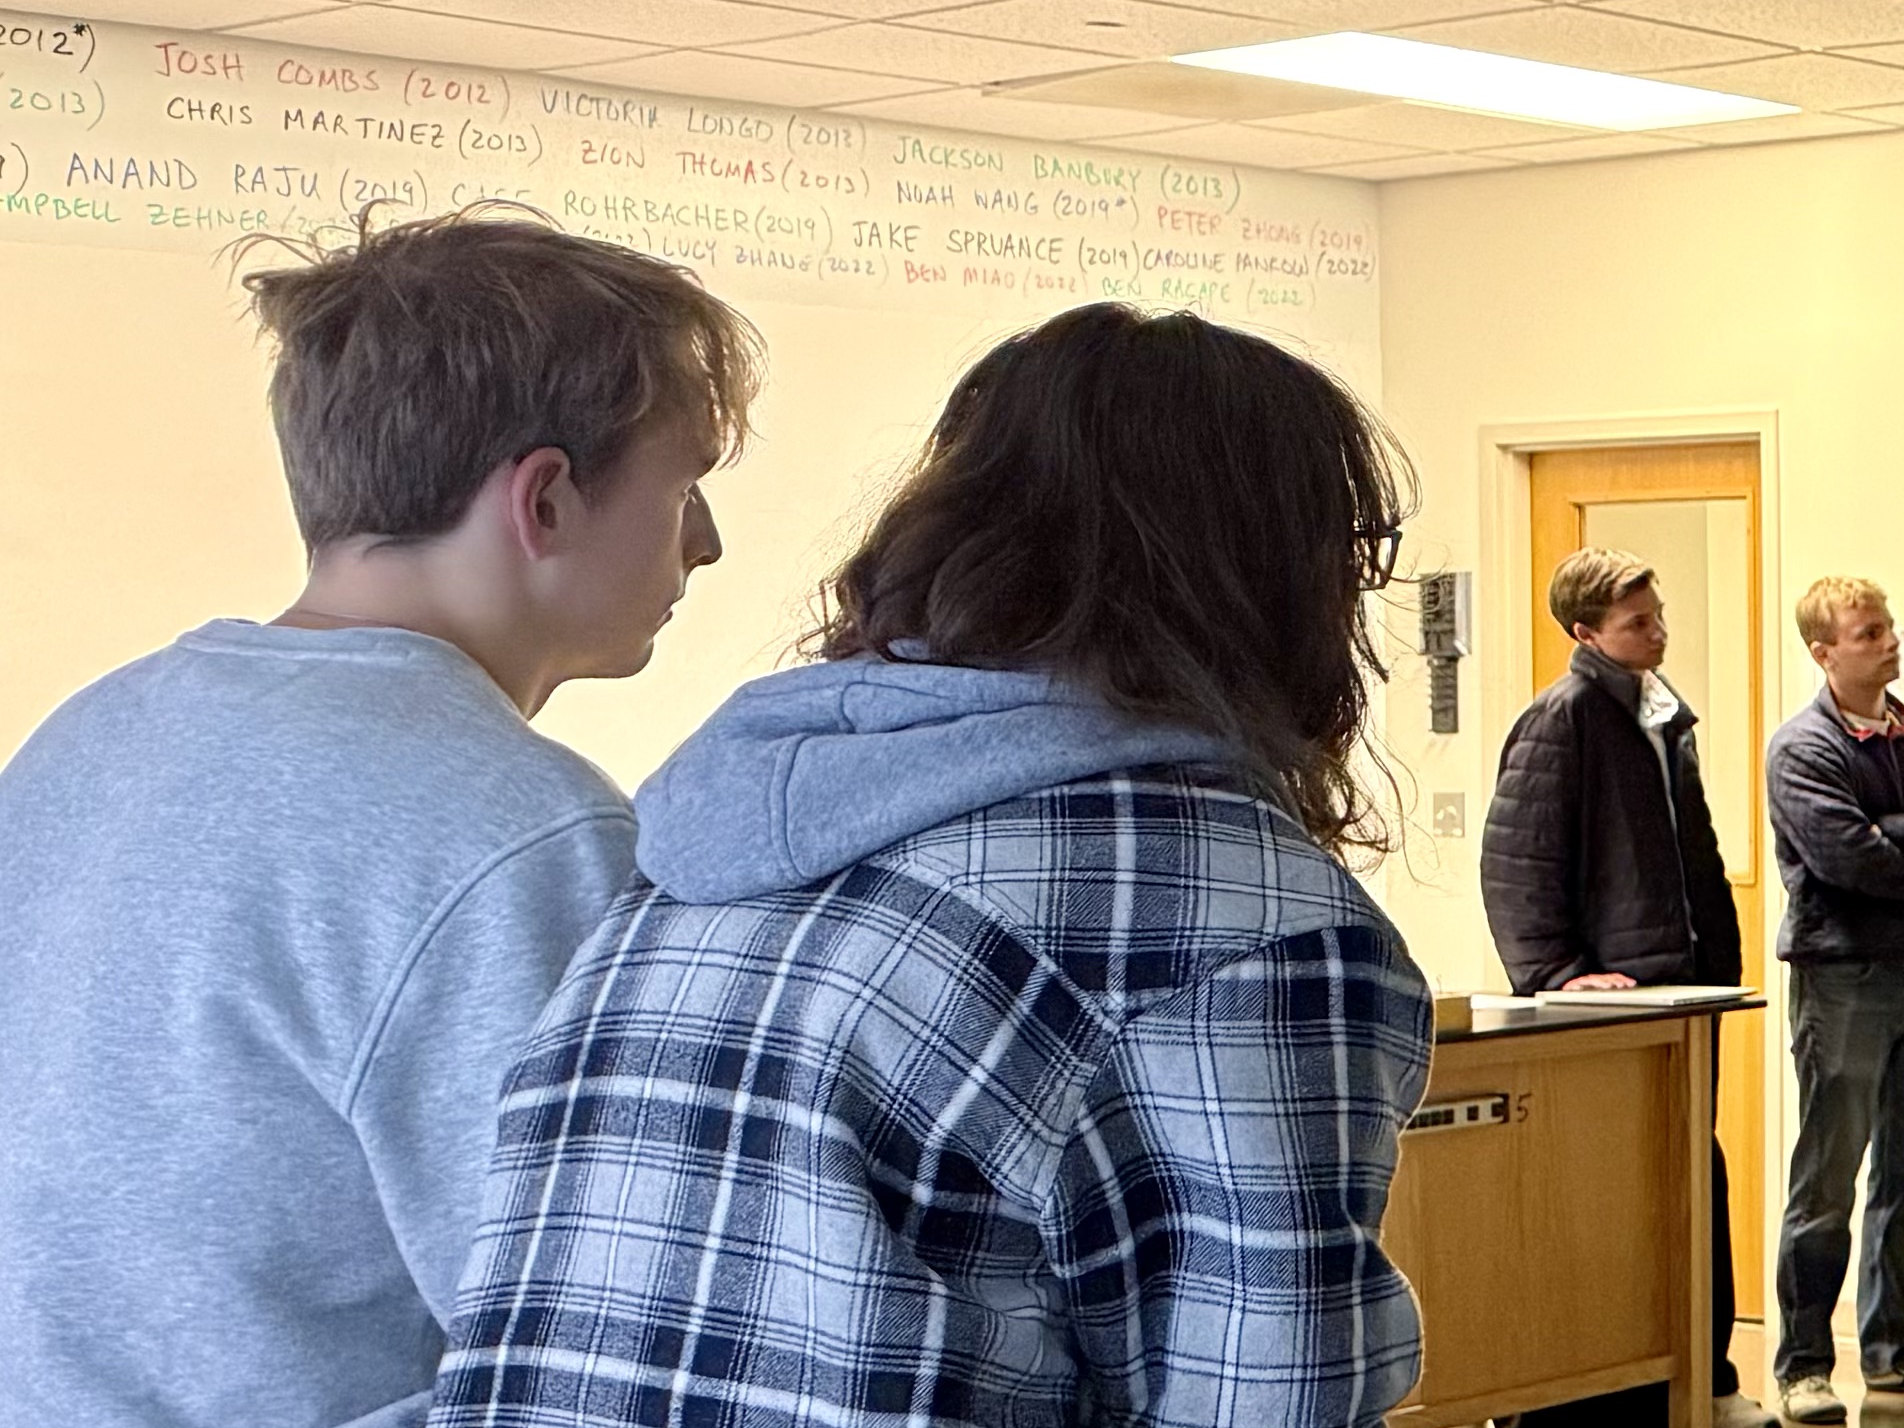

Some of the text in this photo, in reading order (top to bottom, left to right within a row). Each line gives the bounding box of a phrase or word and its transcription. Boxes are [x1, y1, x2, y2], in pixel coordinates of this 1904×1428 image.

[156, 42, 243, 80] JOSH
[278, 60, 379, 92] COMBS
[404, 68, 510, 122] (2012)
[687, 107, 774, 142] LONGO
[894, 136, 1004, 171] JACKSON
[167, 97, 252, 125] CHRIS
[284, 109, 445, 148] MARTINEZ
[459, 118, 542, 168] (2013)
[581, 140, 645, 169] ZION
[676, 151, 775, 184] THOMAS
[897, 180, 954, 209] NOAH
[974, 188, 1038, 215] WANG
[1158, 206, 1222, 236] PETER
[67, 153, 197, 190] ANAND
[234, 163, 321, 201] RAJU
[564, 190, 749, 233] ROHRBACHER
[852, 222, 921, 252] JAKE
[946, 228, 1064, 263] SPRUANCE
[1078, 237, 1139, 280] (2019)
[148, 203, 268, 232] ZEHNER
[663, 237, 717, 267] LUCY
[904, 259, 947, 284] BEN
[1102, 277, 1143, 298] BEN
